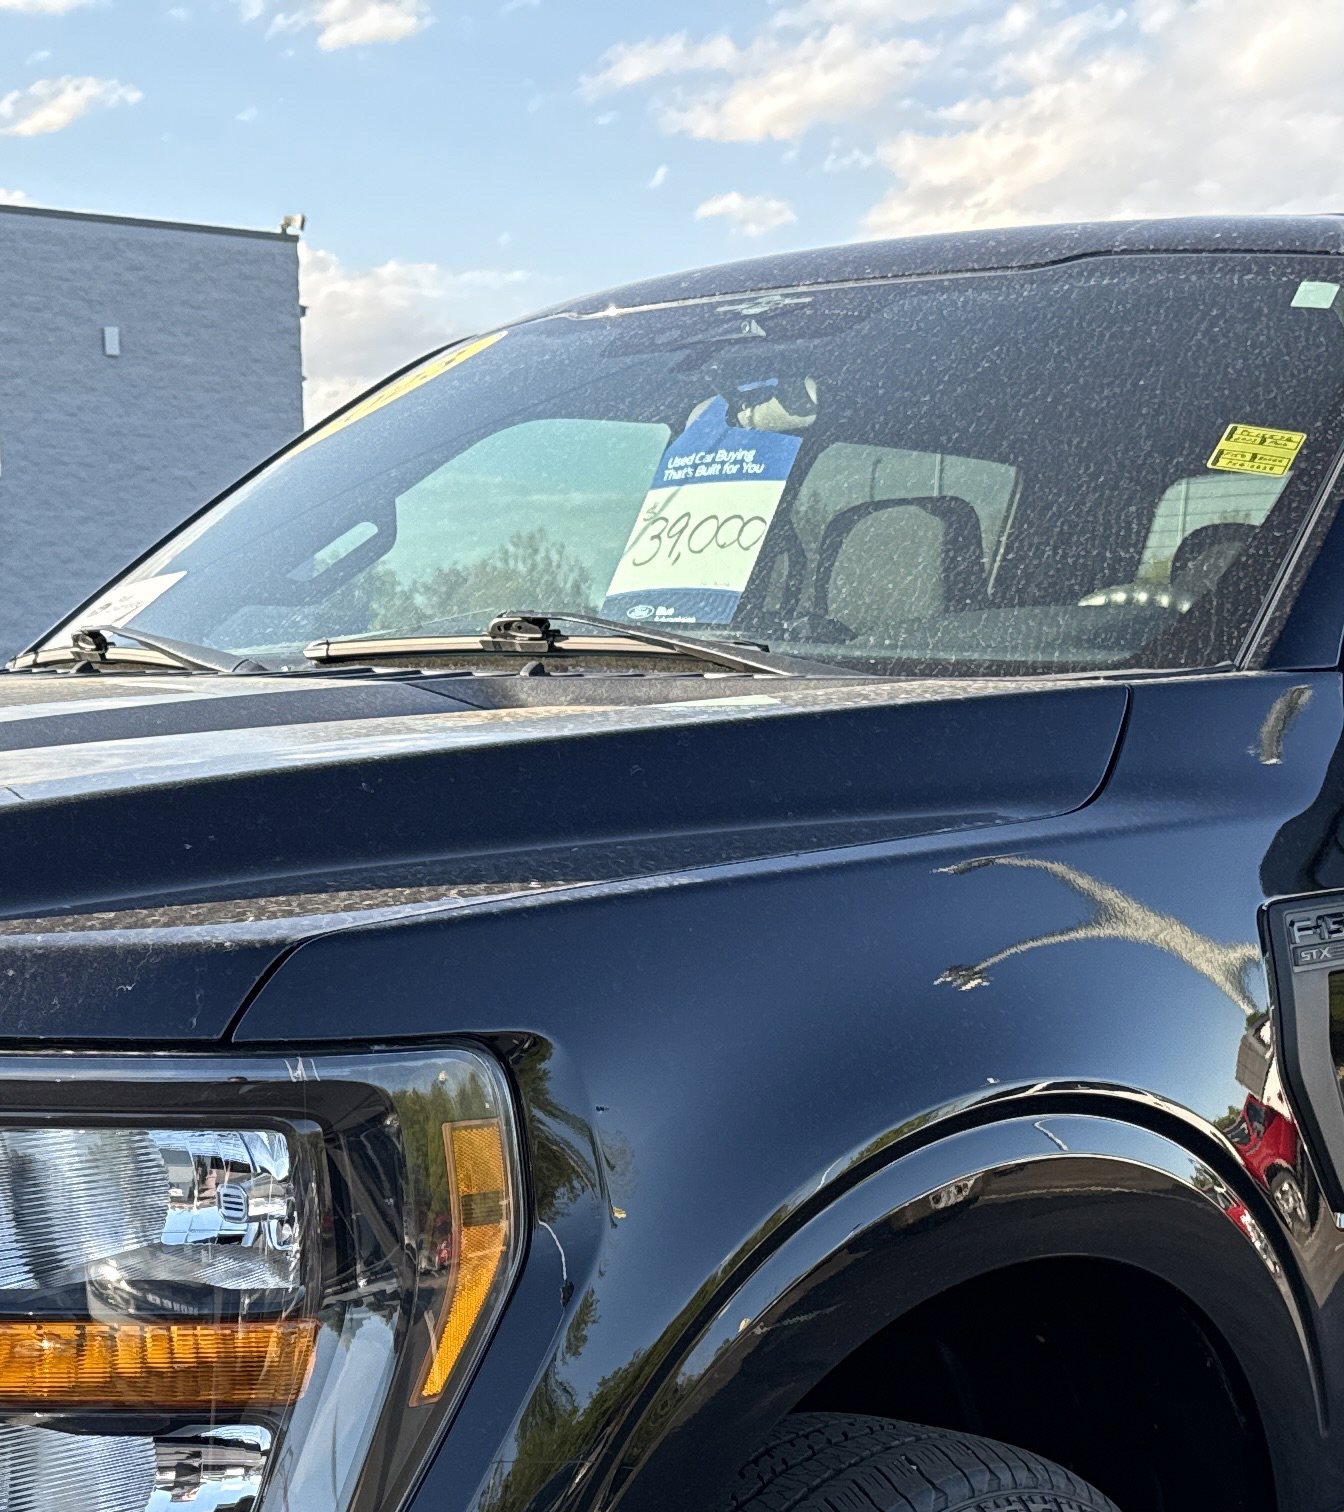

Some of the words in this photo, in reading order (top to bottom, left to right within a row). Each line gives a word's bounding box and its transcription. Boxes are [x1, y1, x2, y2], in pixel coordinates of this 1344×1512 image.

[668, 453, 695, 469] Used
[695, 451, 715, 464] Car
[716, 448, 756, 463] Buying
[663, 467, 694, 481] That's
[695, 463, 721, 477] Built
[722, 462, 741, 475] for
[743, 462, 765, 474] You
[1300, 946, 1333, 962] STX
